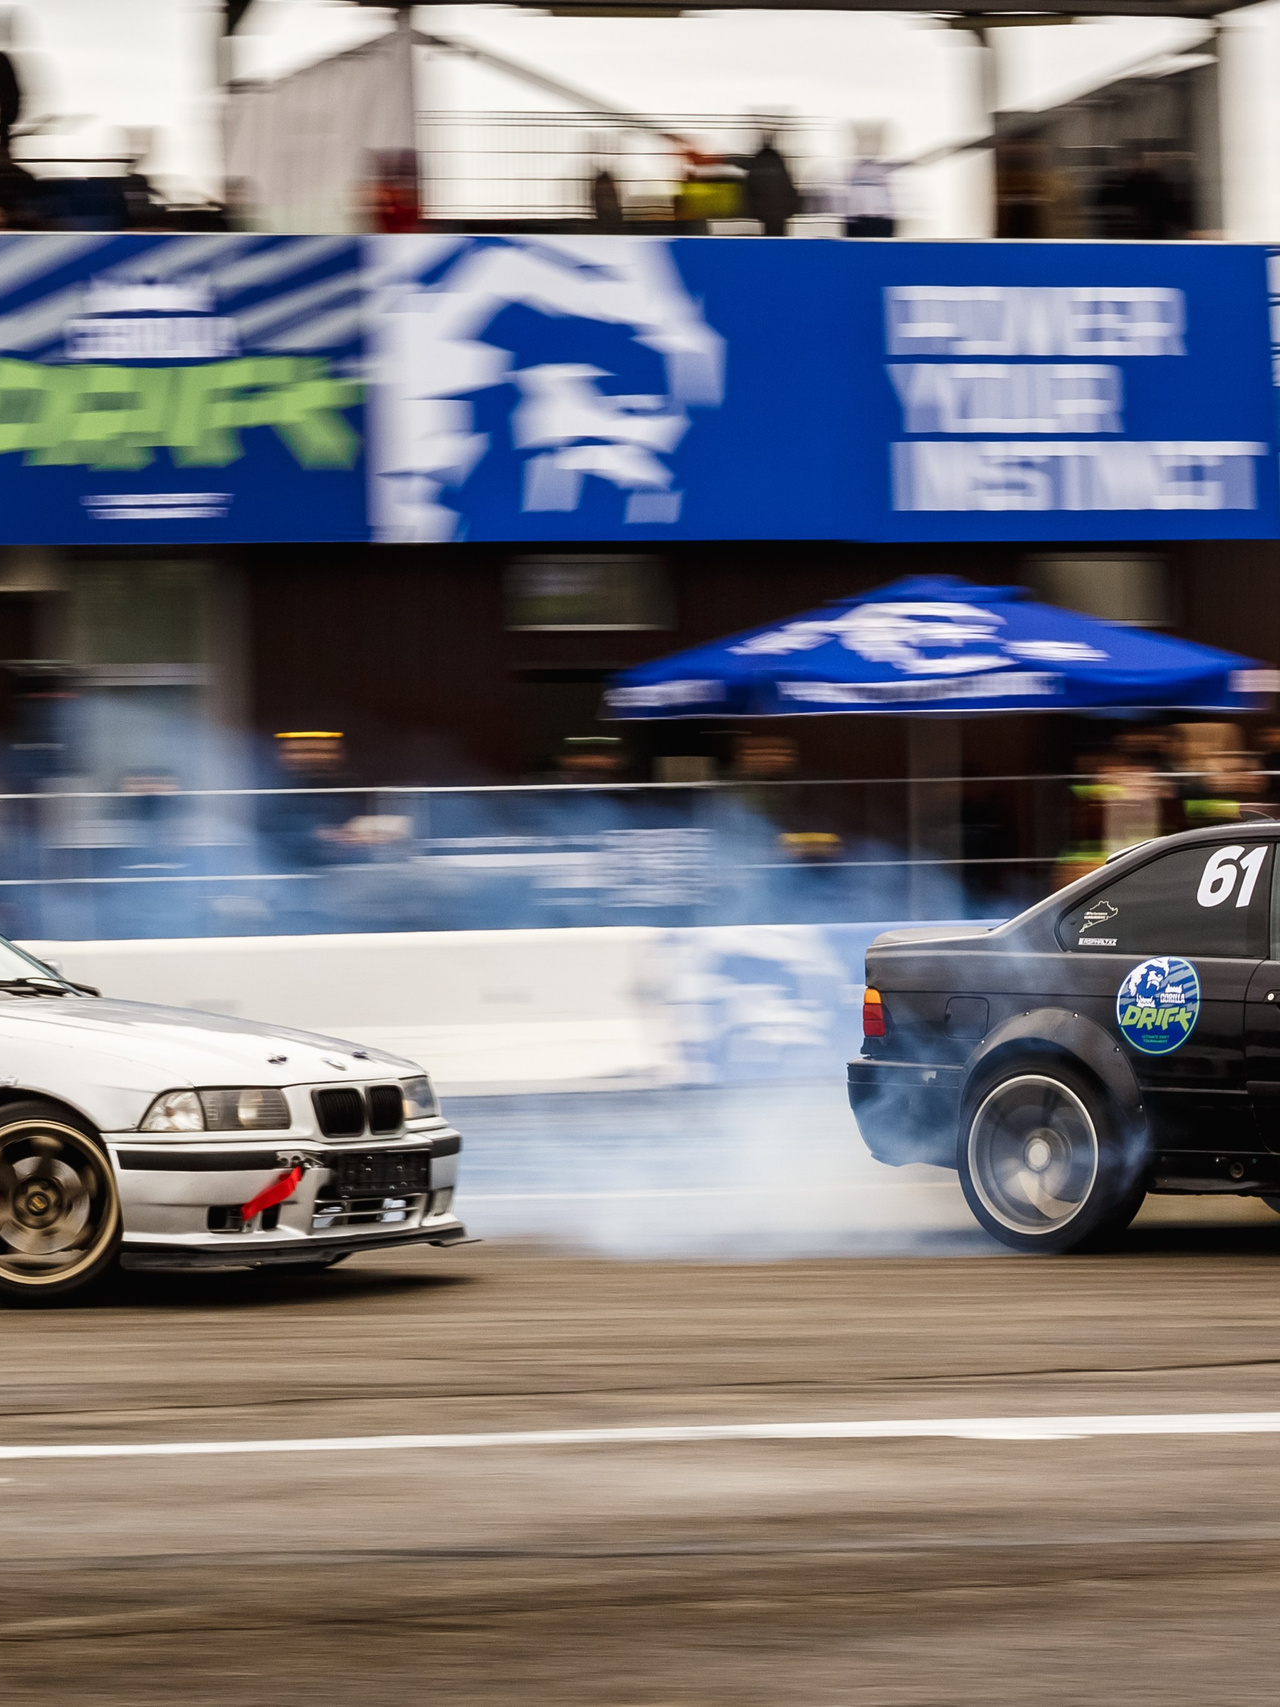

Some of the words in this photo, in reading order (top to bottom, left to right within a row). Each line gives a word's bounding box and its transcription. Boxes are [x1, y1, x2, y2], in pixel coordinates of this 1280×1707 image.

[1197, 845, 1269, 908] 61
[1160, 993, 1186, 1004] GORILLA
[1121, 1005, 1193, 1032] DRIFT
